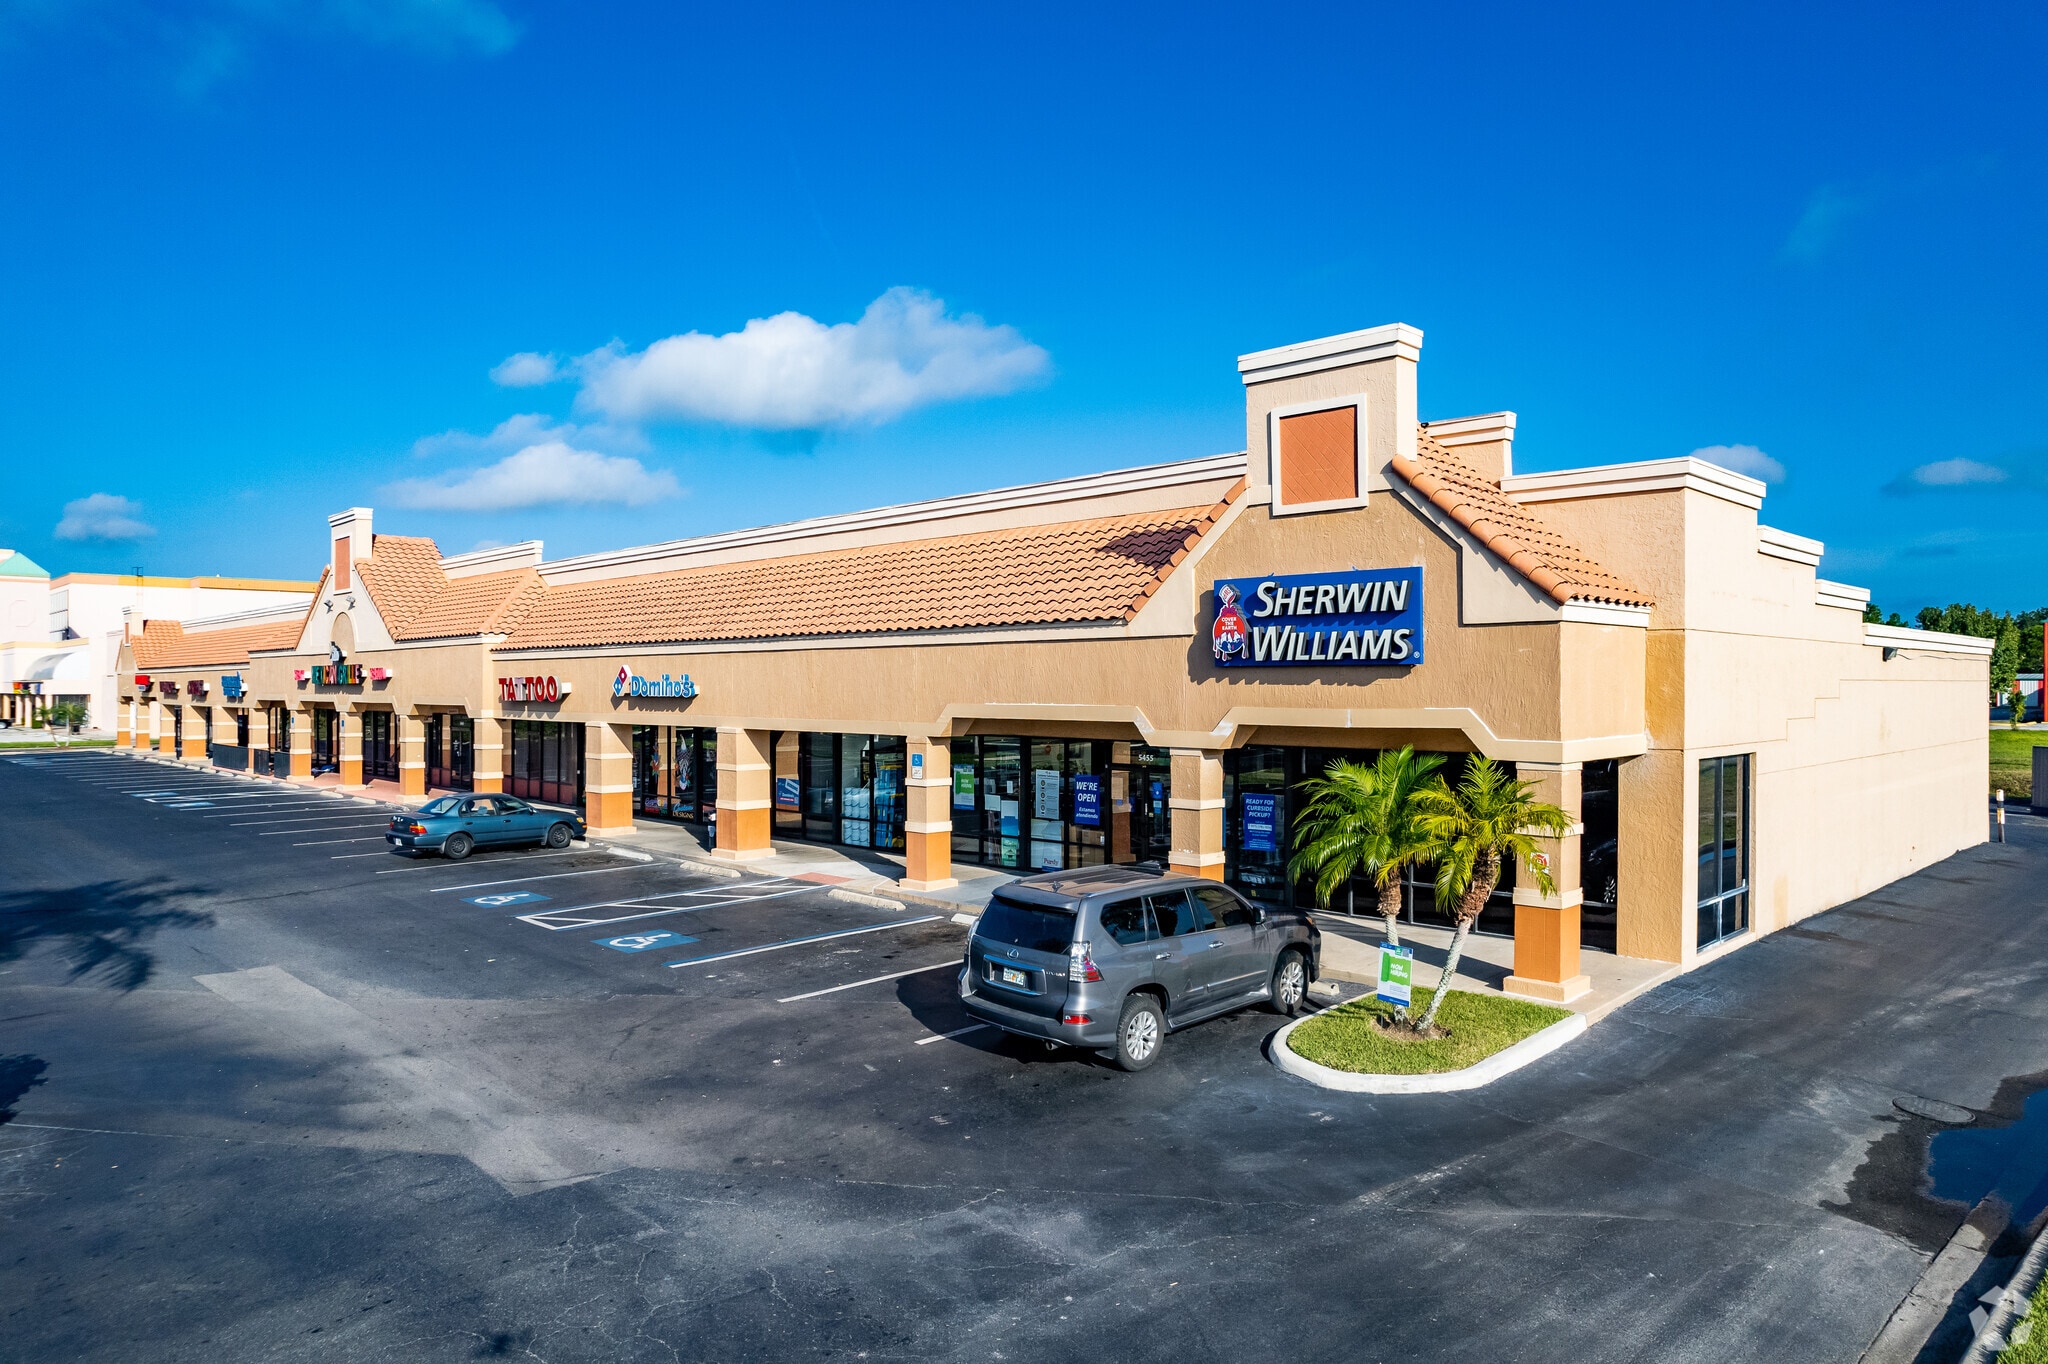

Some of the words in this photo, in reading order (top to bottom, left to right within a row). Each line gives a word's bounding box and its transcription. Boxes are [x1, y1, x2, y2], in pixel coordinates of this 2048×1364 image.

[1253, 579, 1411, 617] SHERWIN
[1253, 625, 1412, 661] WILLIAMS
[498, 675, 561, 703] TATTOO
[630, 673, 696, 698] Domino's
[1138, 754, 1154, 762] 5455
[1076, 781, 1098, 791] WE'RE
[1077, 793, 1097, 803] OPEN
